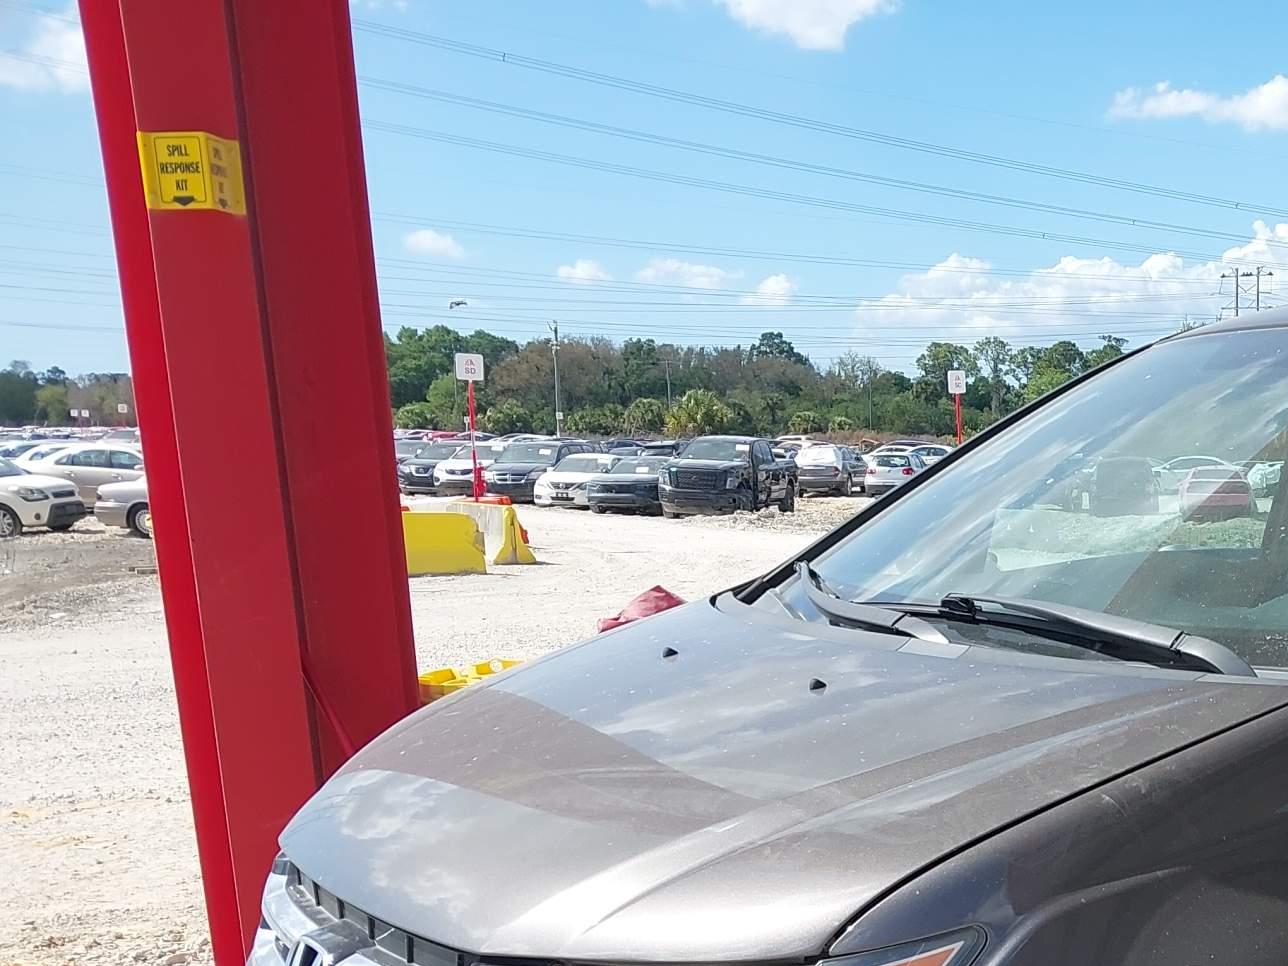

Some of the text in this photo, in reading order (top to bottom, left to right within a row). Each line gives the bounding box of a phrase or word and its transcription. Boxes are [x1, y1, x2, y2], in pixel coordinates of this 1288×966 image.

[166, 144, 190, 157] SPILL
[159, 162, 201, 174] RESPONSE
[175, 179, 188, 191] KIT
